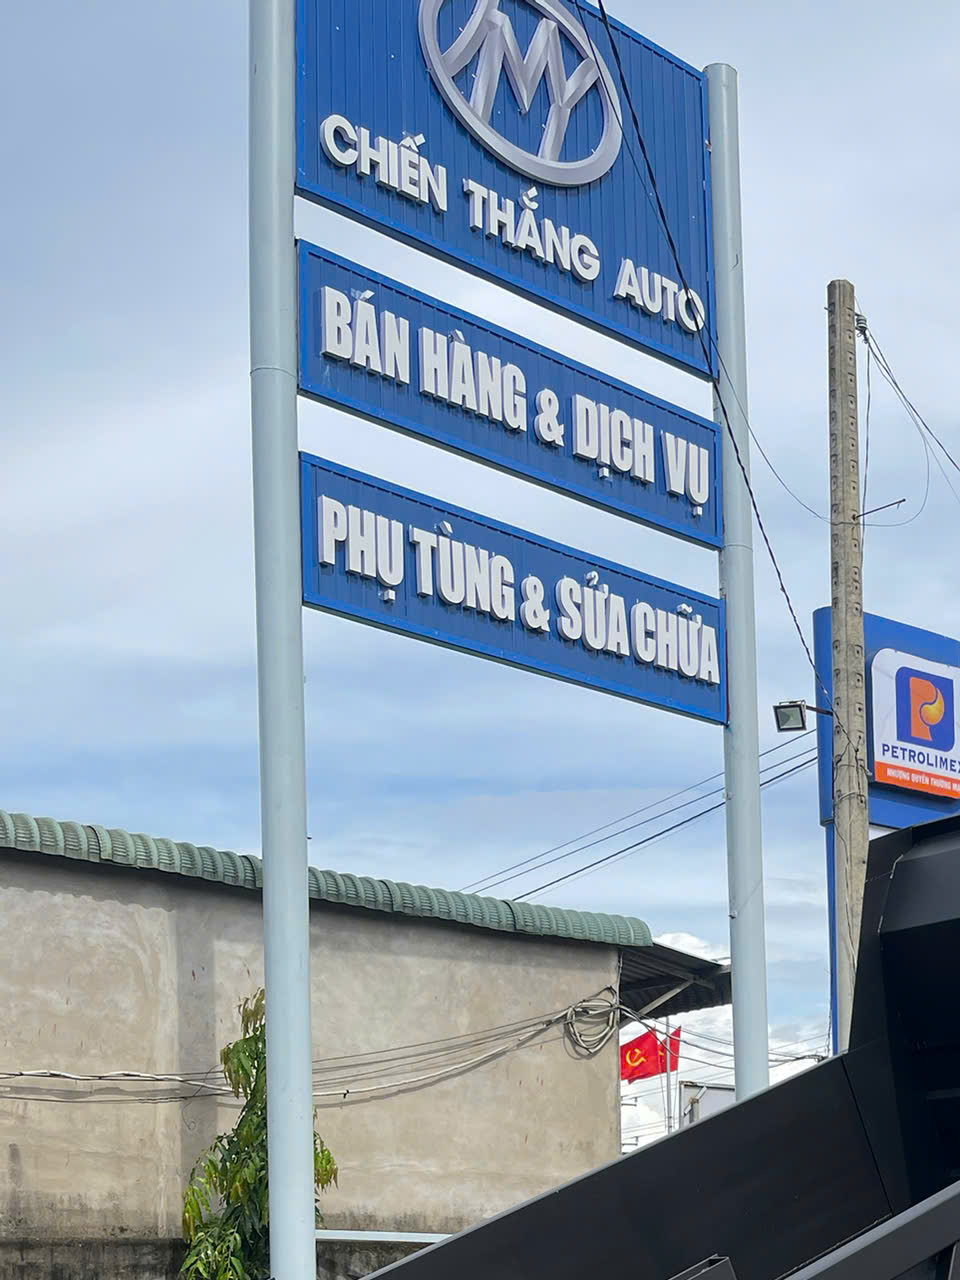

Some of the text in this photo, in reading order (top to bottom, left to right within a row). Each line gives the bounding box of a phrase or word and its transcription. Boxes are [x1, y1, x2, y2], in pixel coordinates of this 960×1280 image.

[320, 115, 705, 334] CHIẾN THẮNG AUTO
[320, 286, 709, 517] BÁN HÀNG & DỊCH VỤ
[318, 495, 720, 685] PHỤ TÙNG & SỬA CHỮA
